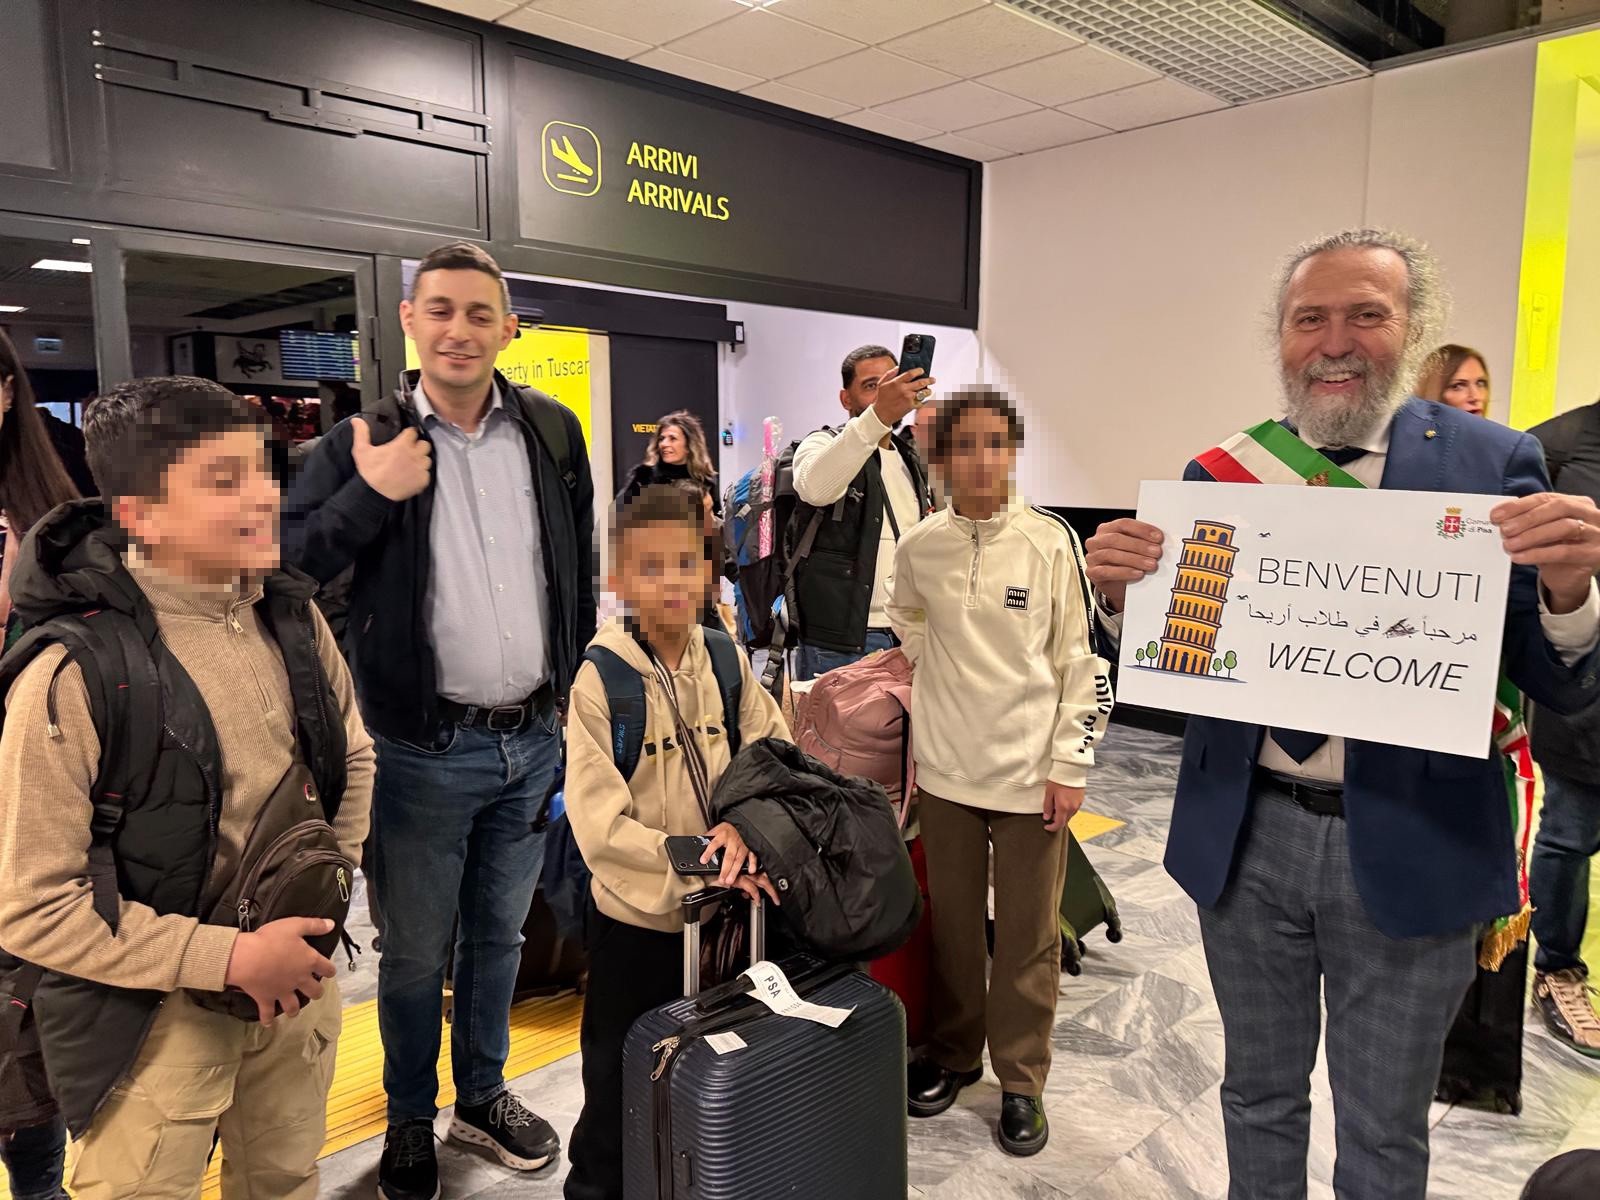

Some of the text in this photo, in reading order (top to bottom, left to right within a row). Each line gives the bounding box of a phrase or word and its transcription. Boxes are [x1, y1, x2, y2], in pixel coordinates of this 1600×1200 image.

[626, 141, 698, 179] ARRIVI
[627, 178, 729, 221] ARRIVALS
[532, 359, 544, 379] in
[1258, 557, 1481, 603] BENVENUTI
[1298, 610, 1349, 628] طلاب
[1355, 615, 1379, 637] في
[1268, 642, 1469, 692] WELCOME
[763, 975, 782, 999] PSA
